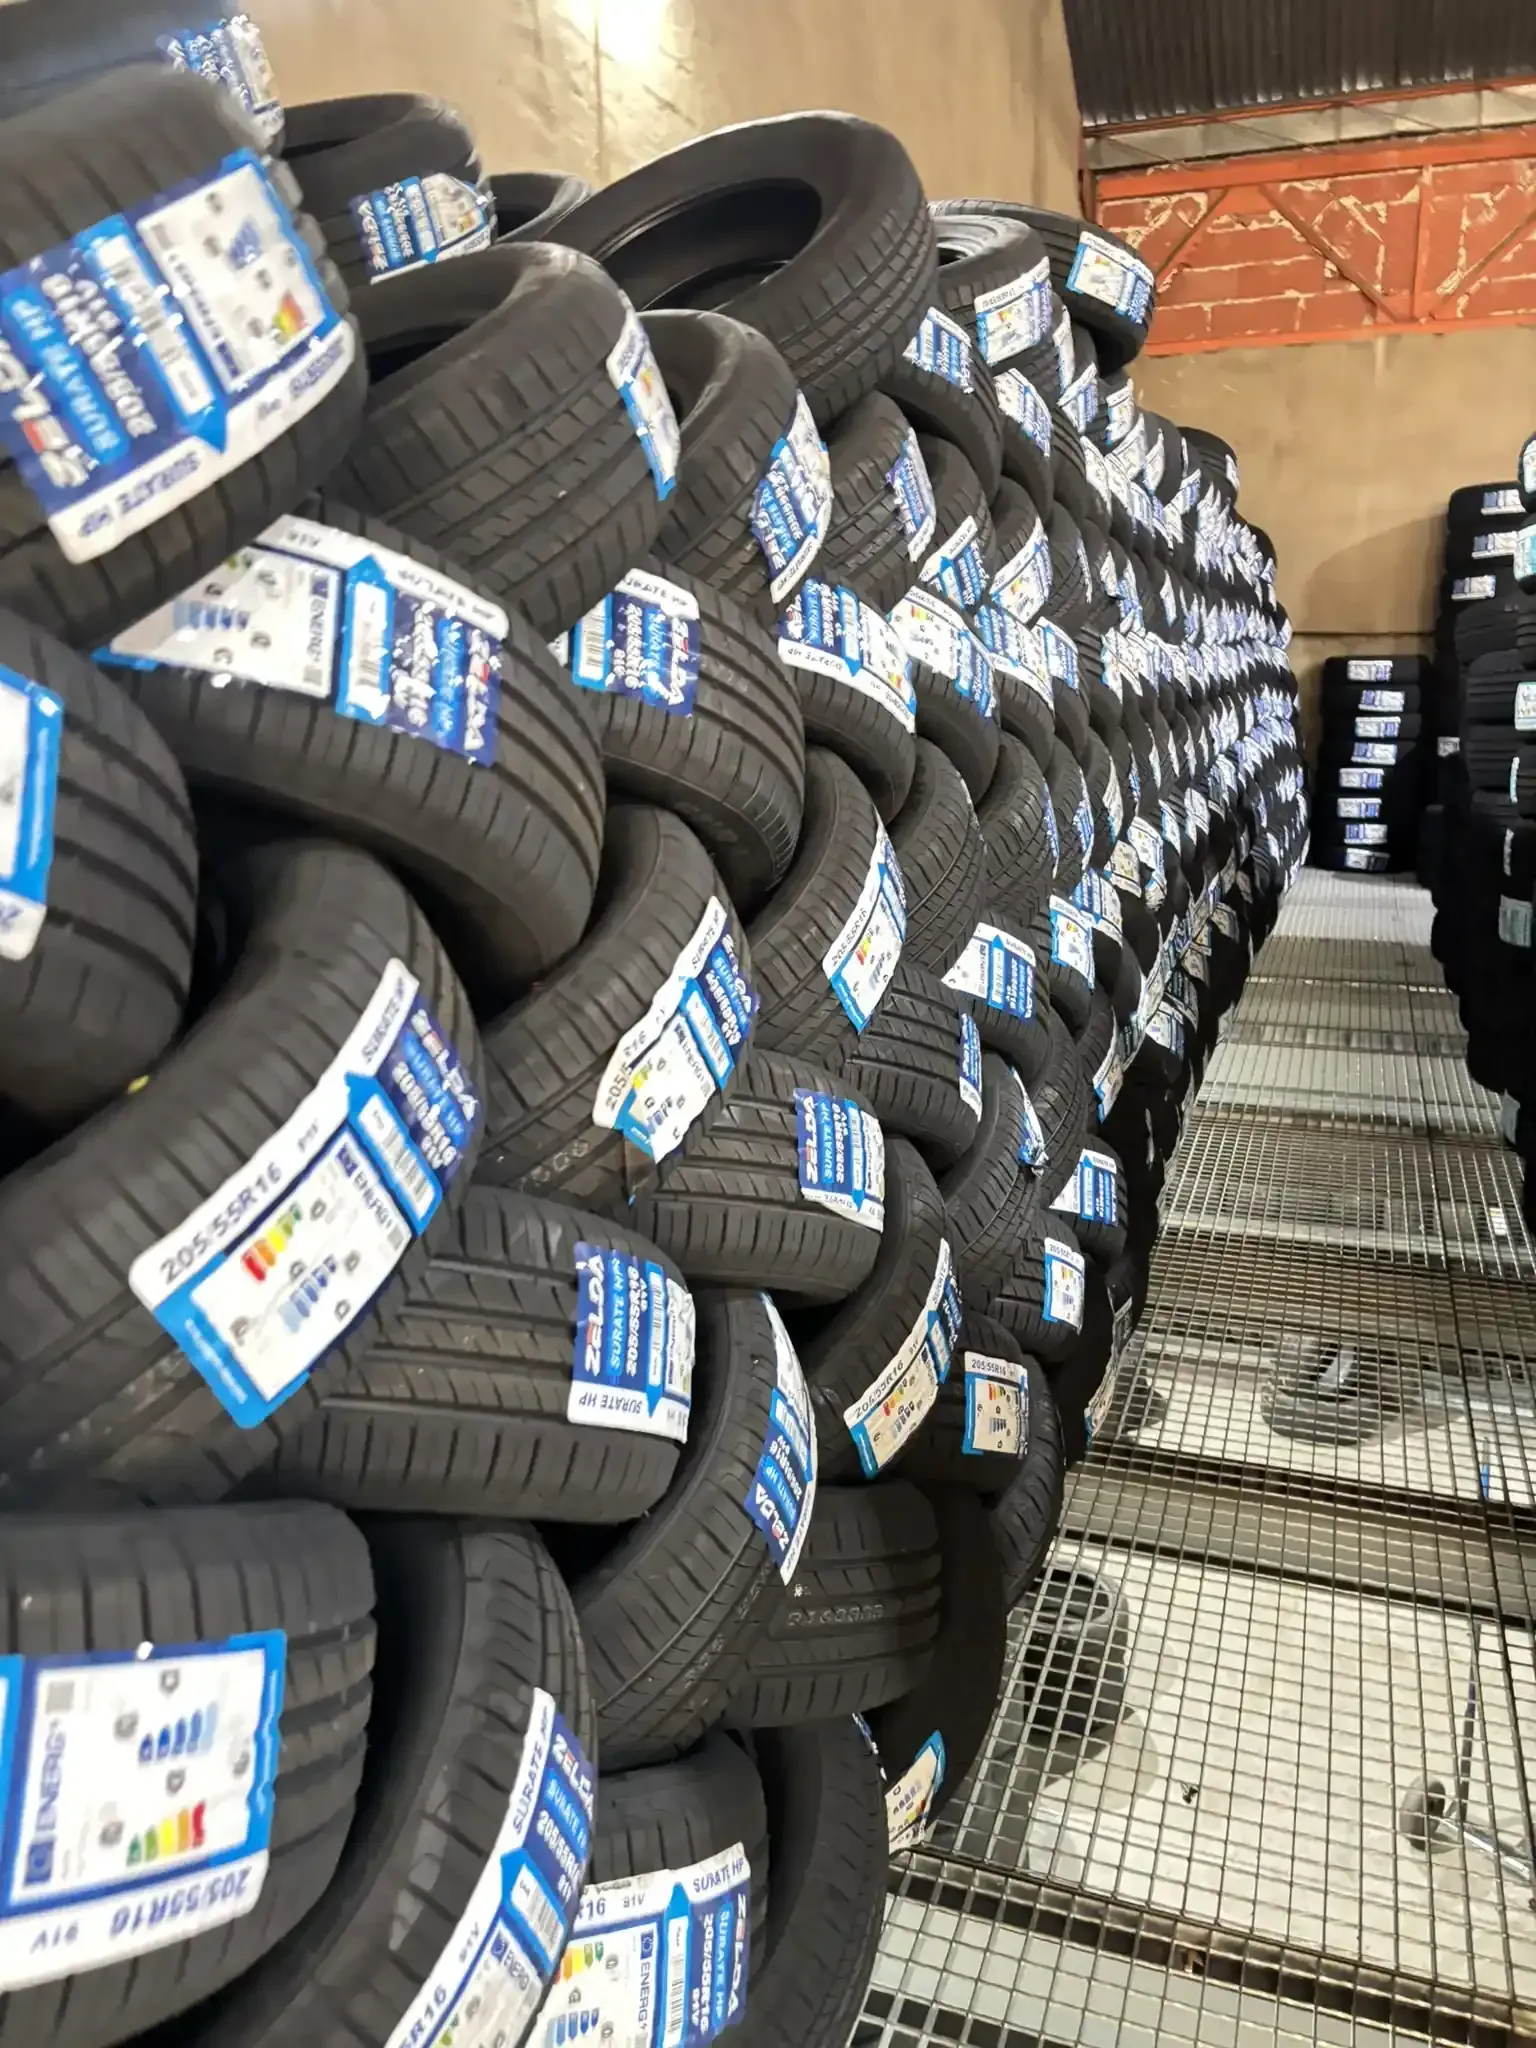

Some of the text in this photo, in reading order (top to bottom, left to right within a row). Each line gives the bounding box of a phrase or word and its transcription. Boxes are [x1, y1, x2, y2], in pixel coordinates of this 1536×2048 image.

[803, 1095, 817, 1184] ZELDA
[824, 1124, 832, 1178] SURATE
[585, 1254, 604, 1376] ZELDA
[610, 1294, 624, 1370] SURATE
[626, 1265, 638, 1377] 205/55R16
[578, 1391, 643, 1413] SURATE HP
[752, 1483, 791, 1551] ZELDA
[510, 1745, 546, 1835] SURATE
[109, 1865, 251, 1939] 205/55R16
[693, 1858, 745, 1892] SURATE HP
[699, 1912, 714, 2029] 205/55R16
[715, 1910, 730, 1987] SURATE
[727, 1892, 746, 2016] ZELDA
